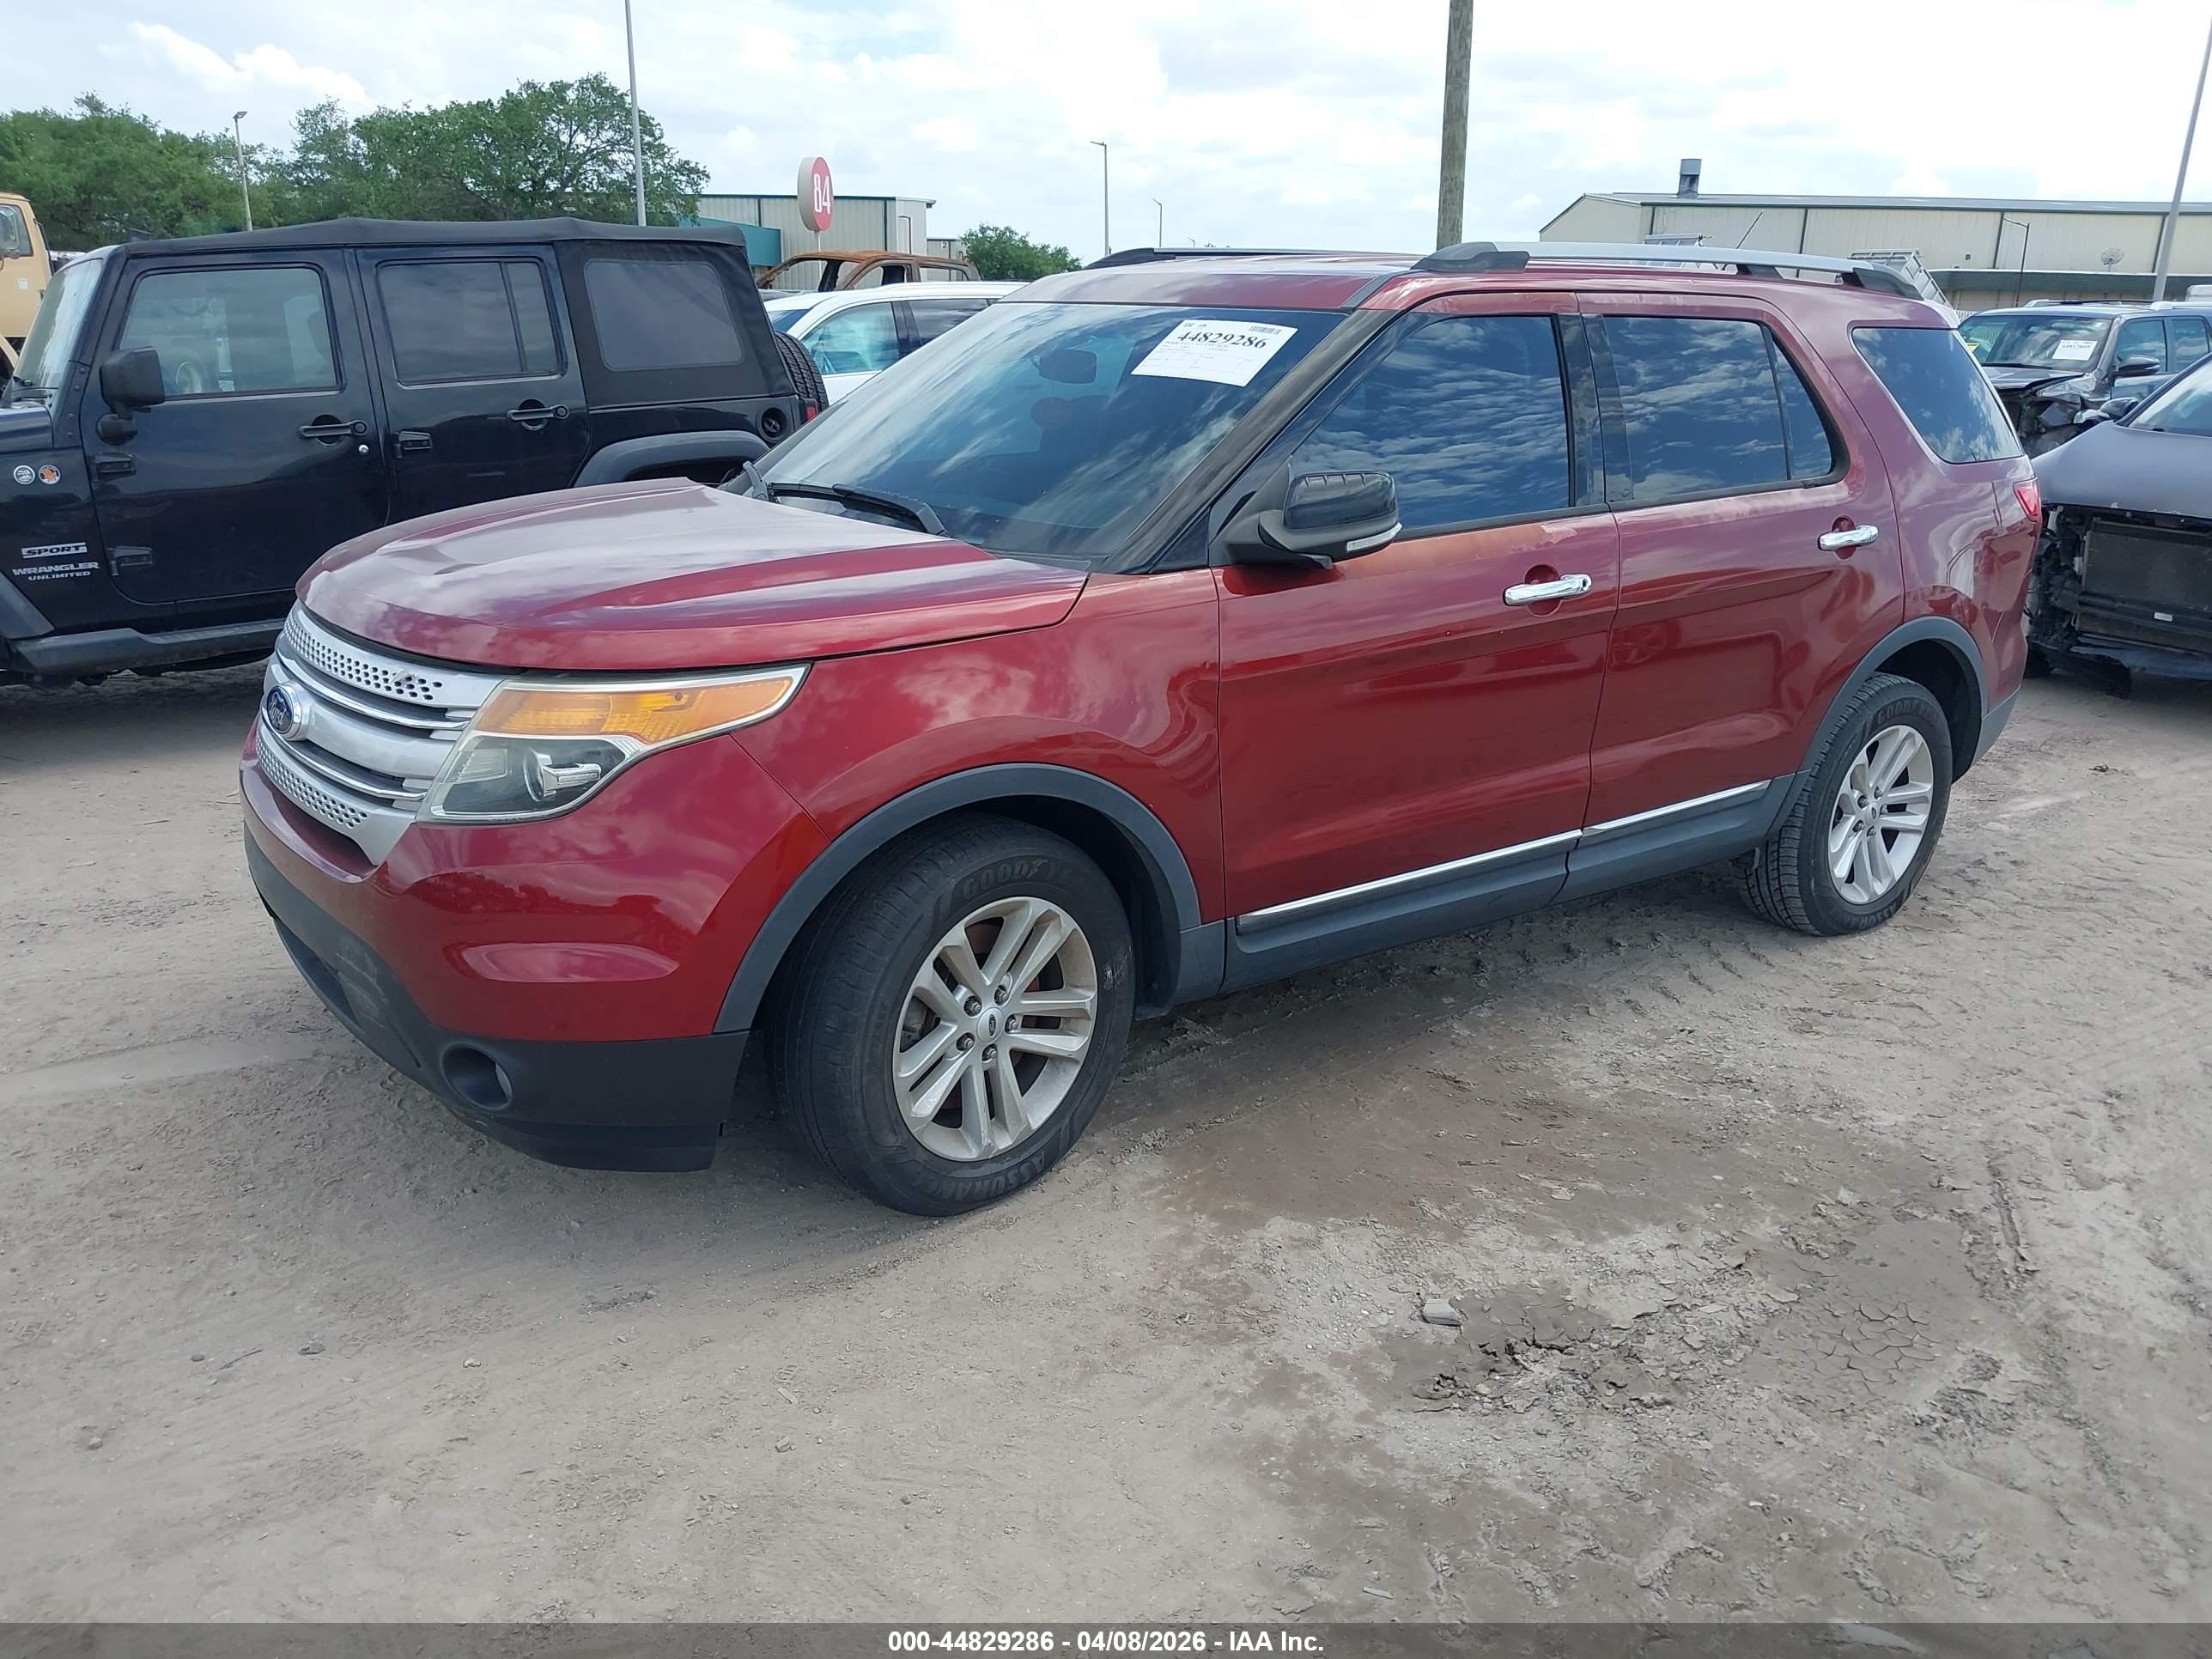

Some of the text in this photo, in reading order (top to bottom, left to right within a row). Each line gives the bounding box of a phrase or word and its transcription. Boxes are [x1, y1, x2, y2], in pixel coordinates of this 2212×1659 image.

[814, 173, 831, 215] 84
[1177, 331, 1270, 349] 44829286
[26, 545, 82, 556] SPORT
[12, 562, 100, 575] WRANGLER
[28, 571, 91, 580] UNLIMITED
